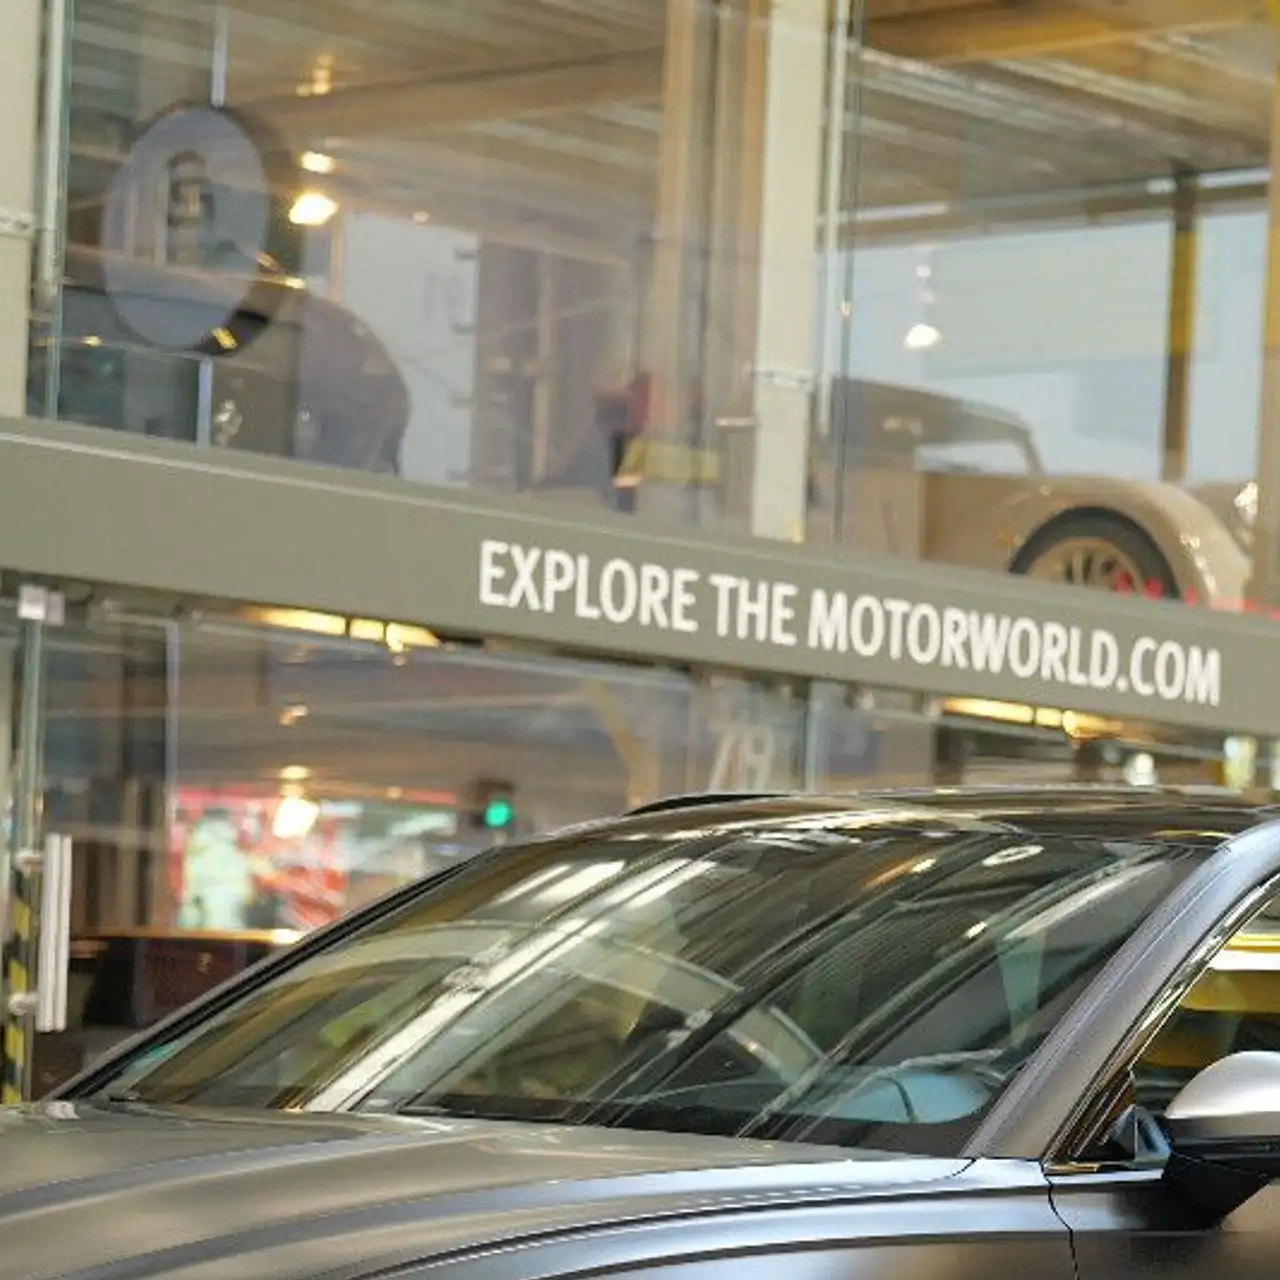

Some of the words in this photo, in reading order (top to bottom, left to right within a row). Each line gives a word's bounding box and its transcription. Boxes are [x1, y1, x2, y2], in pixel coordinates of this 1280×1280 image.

[479, 539, 700, 633] EXPLORE
[708, 573, 799, 647] THE
[807, 588, 1220, 707] MOTORWORLD.COM
